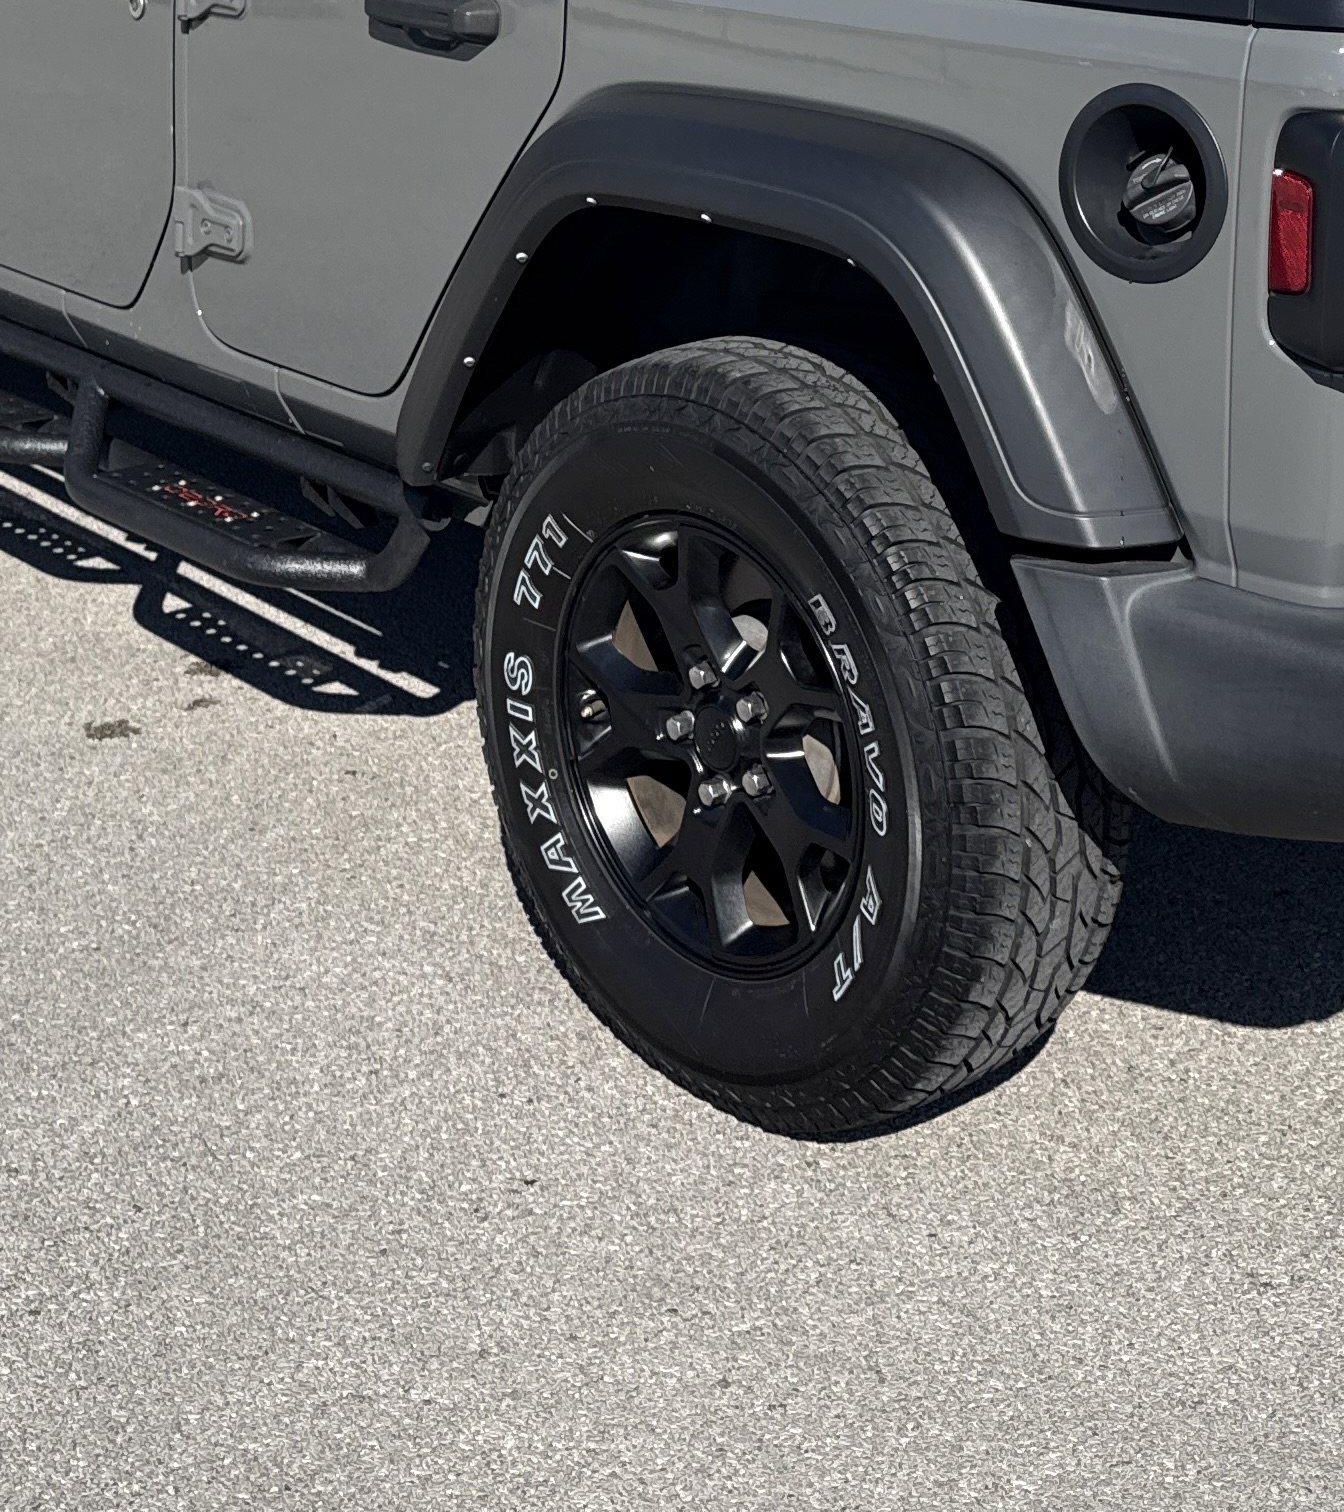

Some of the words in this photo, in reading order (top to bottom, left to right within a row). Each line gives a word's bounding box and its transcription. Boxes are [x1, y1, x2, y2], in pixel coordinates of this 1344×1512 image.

[513, 514, 568, 609] 771
[504, 651, 606, 924] MAXXIS
[807, 593, 889, 837] BRAVO
